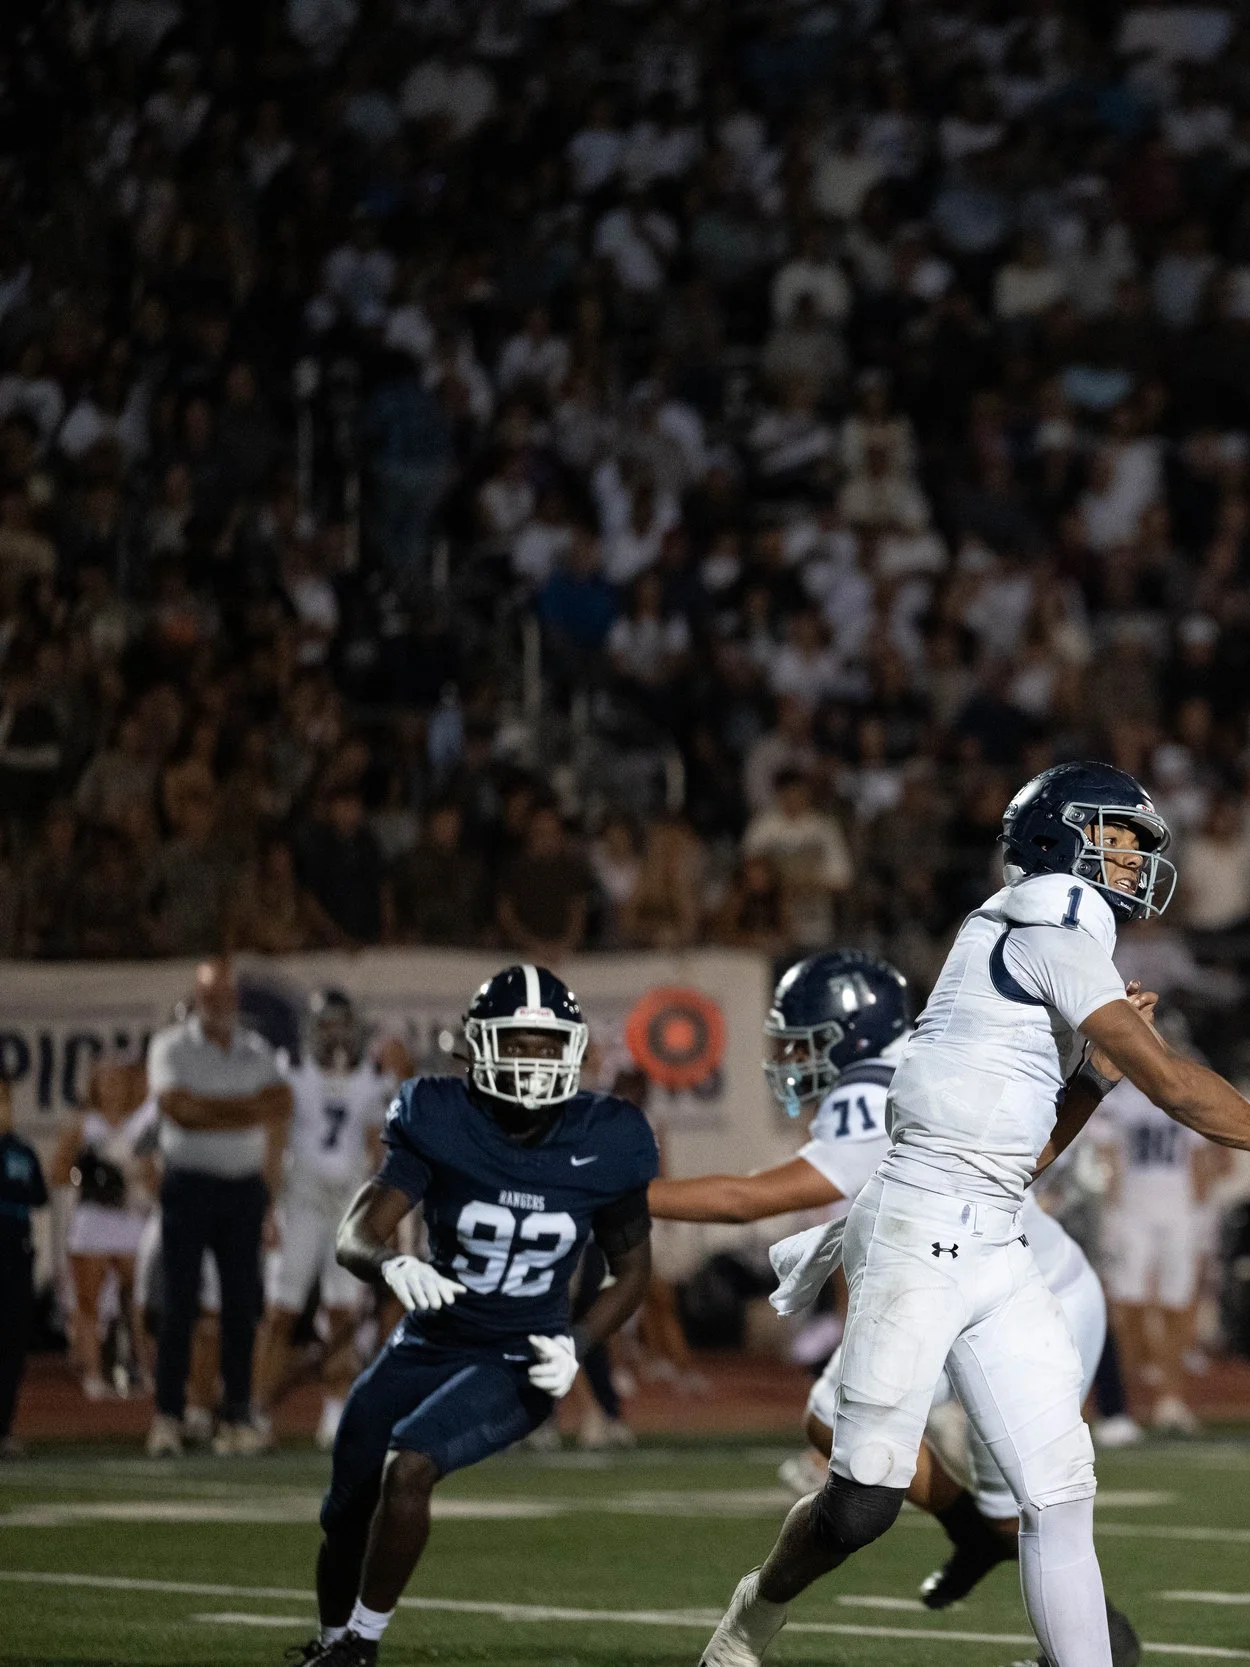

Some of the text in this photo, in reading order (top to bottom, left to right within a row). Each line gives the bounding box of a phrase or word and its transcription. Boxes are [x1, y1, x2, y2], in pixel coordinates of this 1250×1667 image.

[1060, 885, 1084, 930] 1
[322, 1102, 348, 1150] 7
[832, 1095, 877, 1138] 71
[498, 1190, 545, 1212] RANGERS
[451, 1200, 577, 1298] 92
